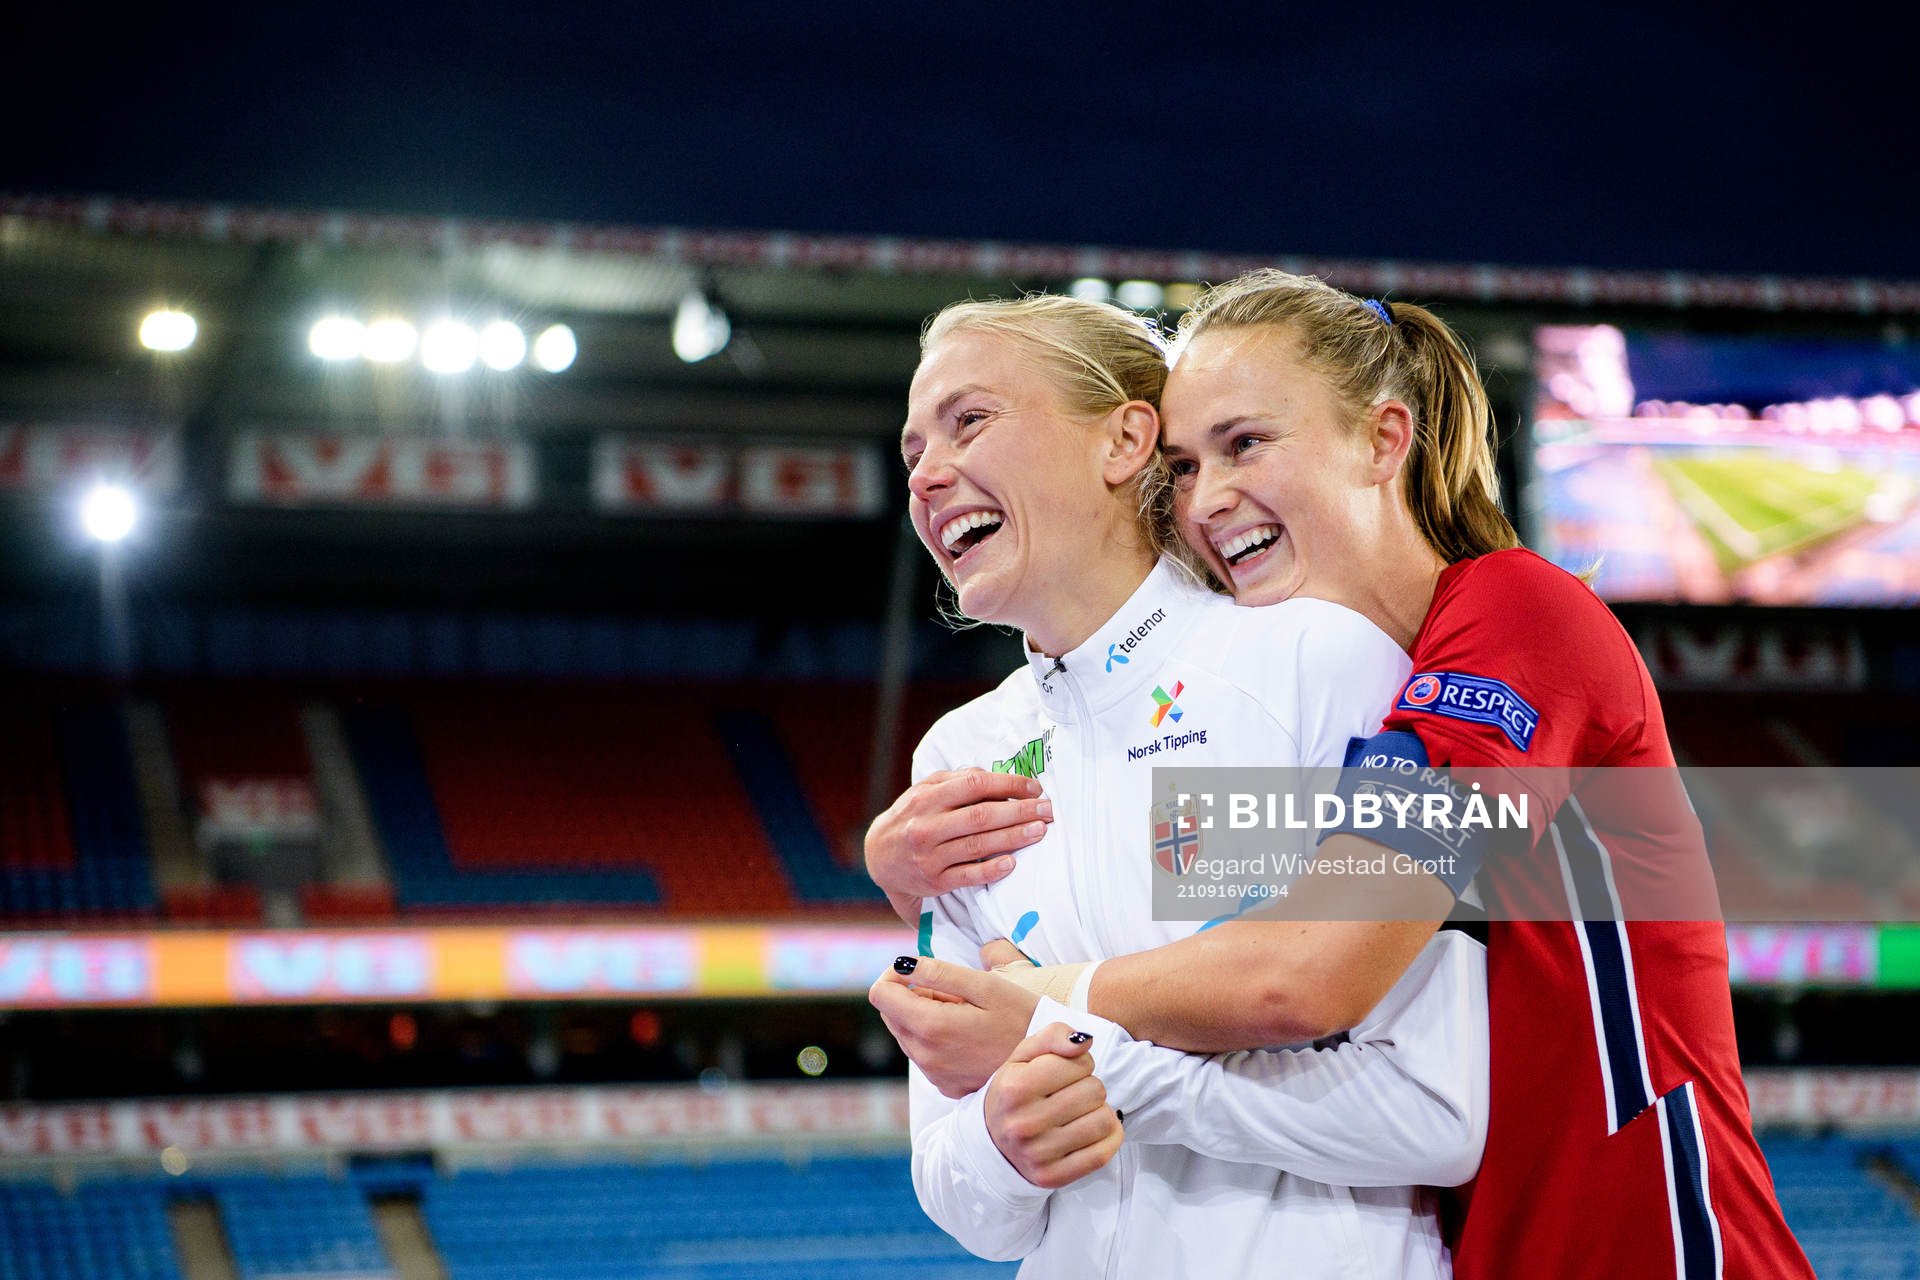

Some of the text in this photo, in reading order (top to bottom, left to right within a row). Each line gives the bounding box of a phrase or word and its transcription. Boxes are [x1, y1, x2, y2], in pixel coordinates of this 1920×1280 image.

[1119, 607, 1166, 653] telenor
[1441, 684, 1536, 738] RESPECT
[1128, 729, 1207, 762] Norsk Tipping
[1360, 754, 1388, 769] NO
[1390, 756, 1417, 775] TO
